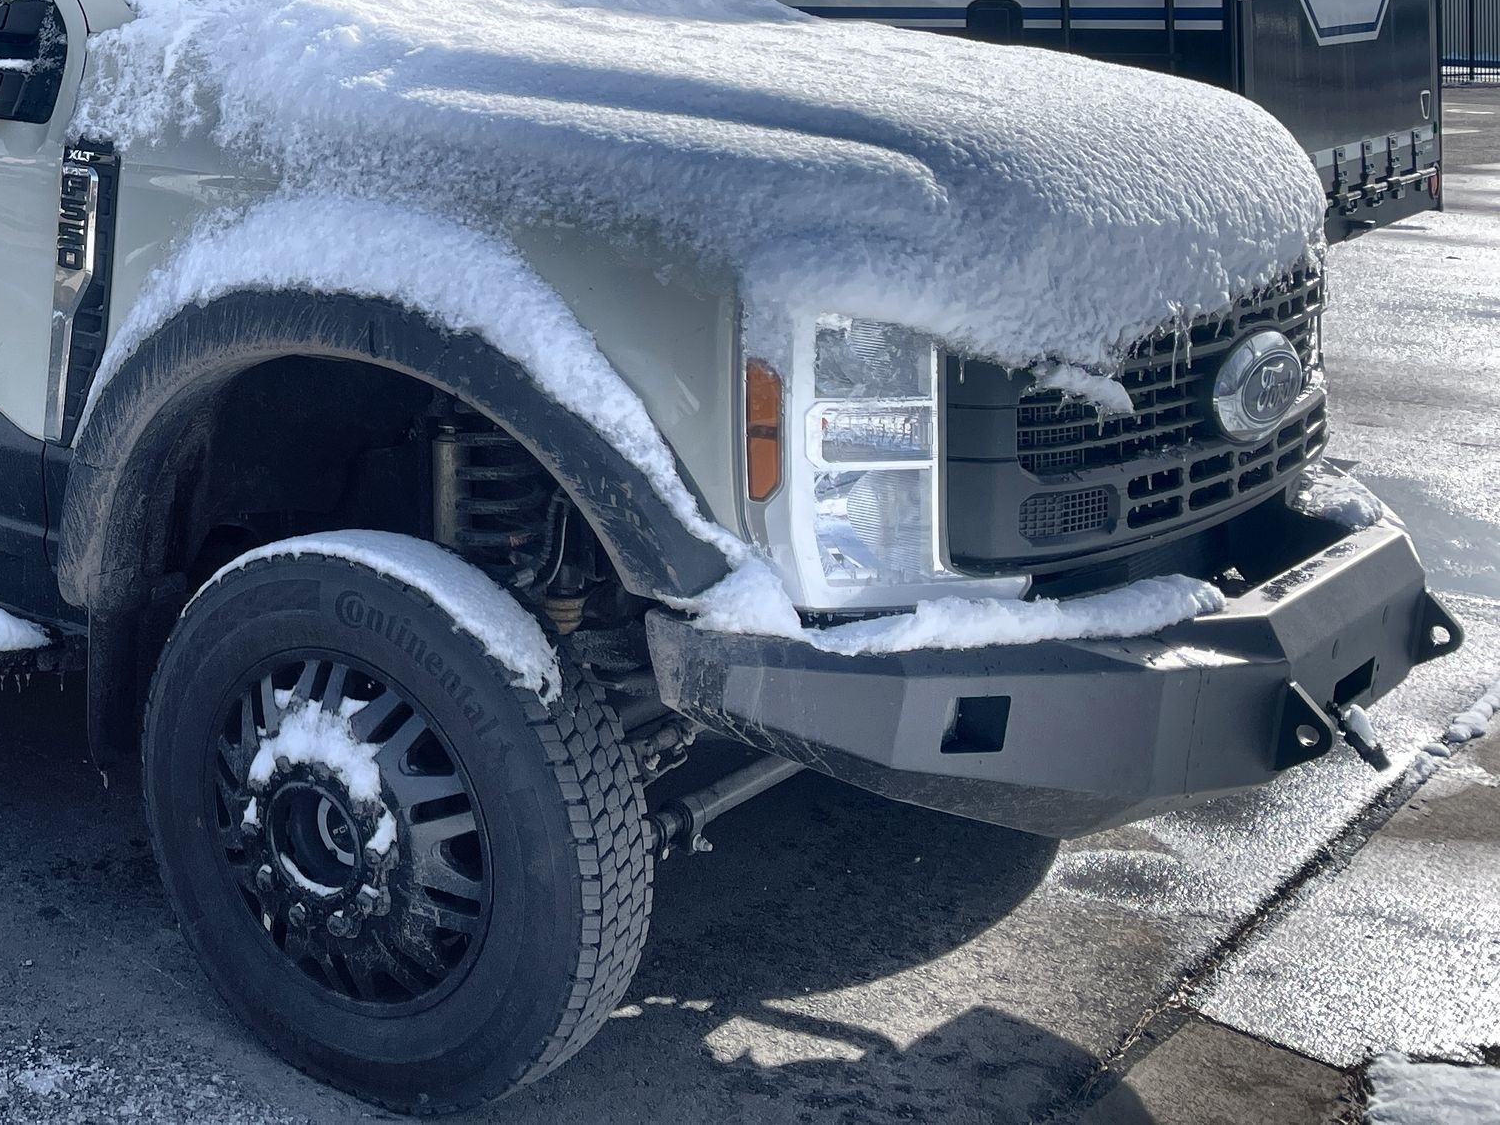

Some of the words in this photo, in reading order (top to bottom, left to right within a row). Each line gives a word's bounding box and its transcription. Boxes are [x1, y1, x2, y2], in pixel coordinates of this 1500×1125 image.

[68, 149, 95, 162] XLT
[1257, 362, 1295, 412] Ford
[334, 590, 501, 740] Continental
